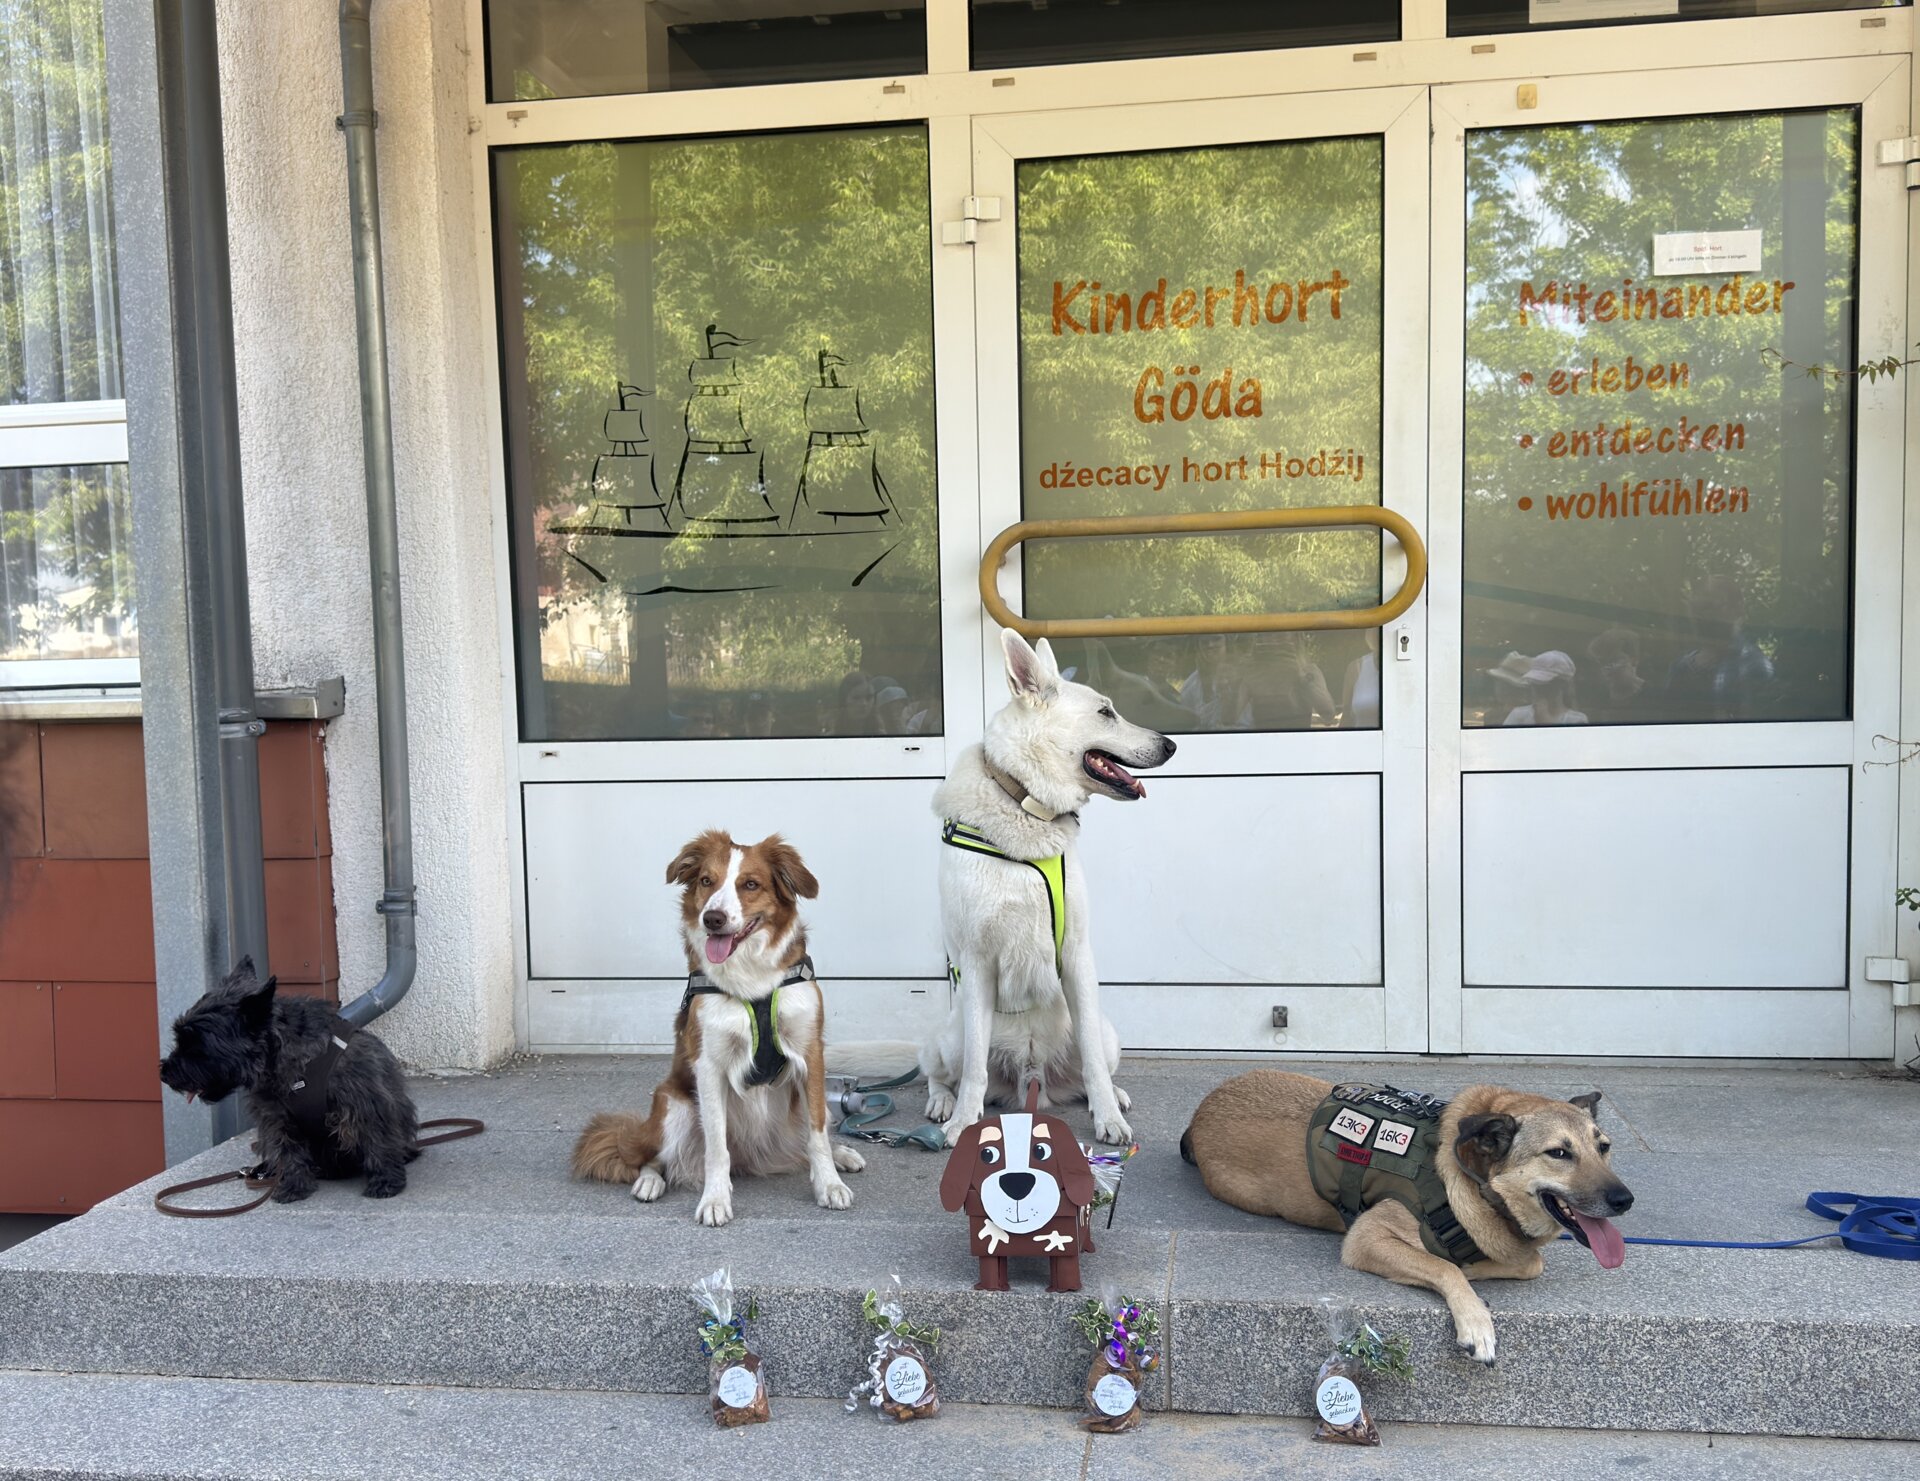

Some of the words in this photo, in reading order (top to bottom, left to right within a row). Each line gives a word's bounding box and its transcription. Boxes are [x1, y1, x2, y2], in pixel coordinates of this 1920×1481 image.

[1052, 269, 1349, 336] Kinderhort
[1519, 273, 1795, 327] Miteinander
[1134, 365, 1264, 424] Göda
[1547, 356, 1690, 396] erleben
[1547, 416, 1746, 459] entdecken
[1182, 455, 1248, 483] hort
[1546, 478, 1749, 521] wohlfühlen
[1337, 1115, 1368, 1136] 13K3
[1379, 1128, 1409, 1146] 16K3
[1321, 1390, 1356, 1411] Liebe
